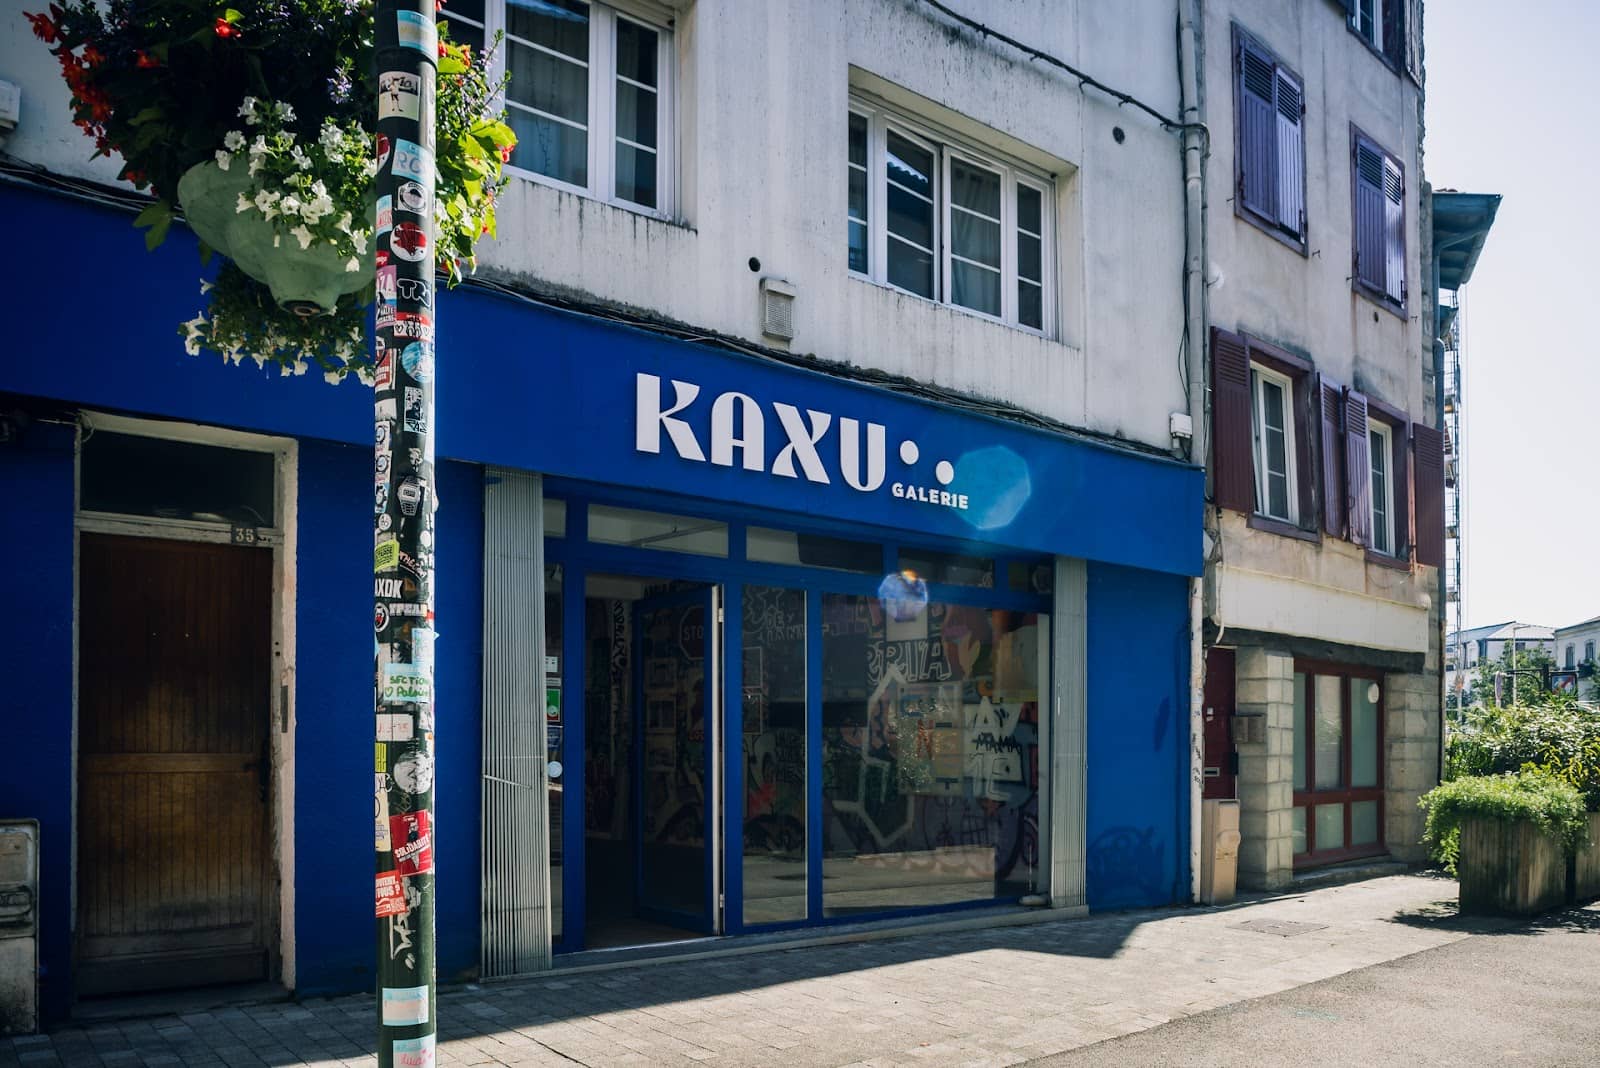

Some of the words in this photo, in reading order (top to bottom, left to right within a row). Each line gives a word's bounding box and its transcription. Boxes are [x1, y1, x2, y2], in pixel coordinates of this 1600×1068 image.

[636, 372, 886, 492] KAXU
[891, 482, 969, 510] GALERIE
[682, 624, 705, 640] STO
